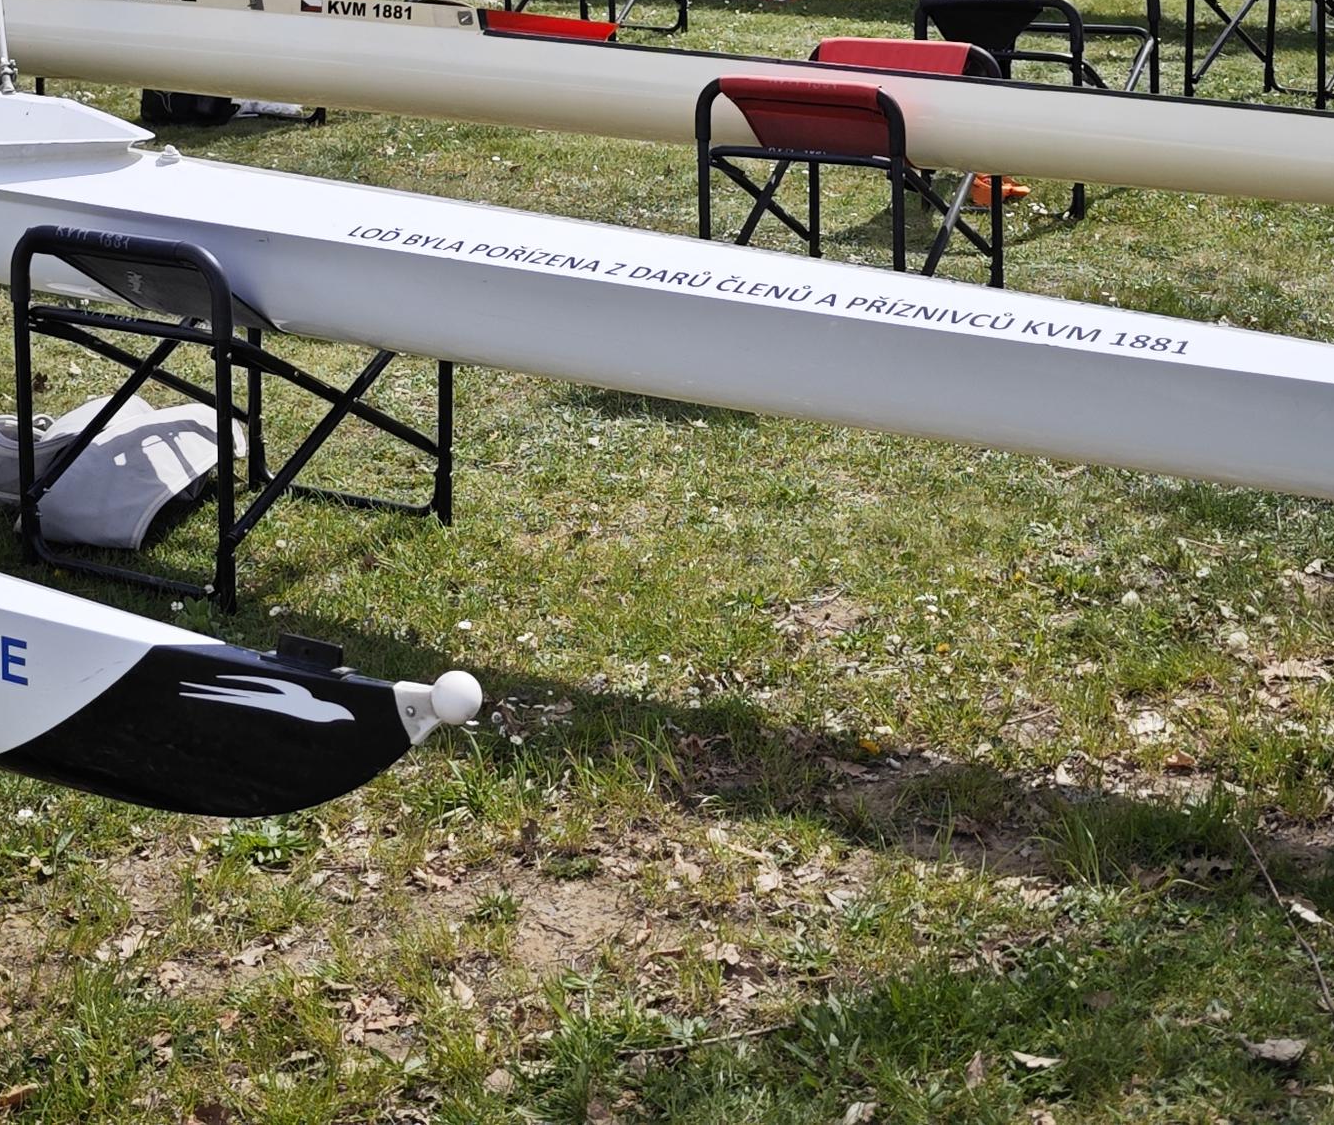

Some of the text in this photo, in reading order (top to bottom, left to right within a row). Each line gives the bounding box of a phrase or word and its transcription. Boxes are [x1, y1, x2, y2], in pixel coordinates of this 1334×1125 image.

[327, 0, 413, 20] KVM 1881
[402, 233, 465, 253] BYLA
[468, 243, 600, 274] POŘÍZENA
[604, 262, 628, 276] Z
[628, 266, 712, 288] DARŮ
[716, 274, 814, 302] ČLENŮ
[814, 292, 837, 307] A
[845, 295, 1016, 331] PŘÍZNIVCŮ
[1021, 320, 1102, 343] KVM
[1108, 331, 1190, 355] 1881
